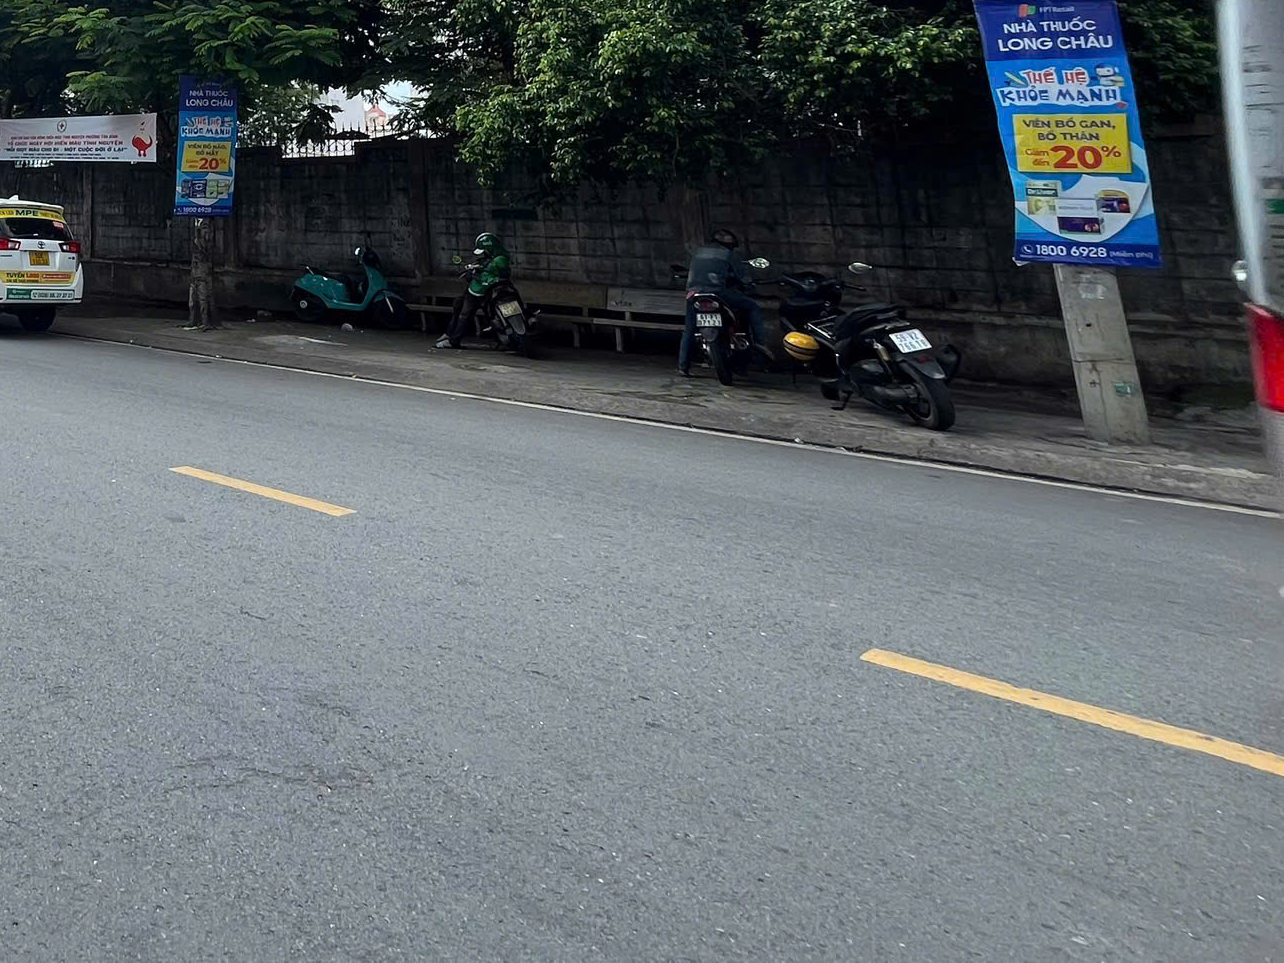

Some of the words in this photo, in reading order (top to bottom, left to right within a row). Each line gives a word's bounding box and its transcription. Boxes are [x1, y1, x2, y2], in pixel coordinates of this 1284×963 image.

[1003, 20, 1037, 34] NHÀ
[1040, 16, 1096, 32] THUỐC
[998, 37, 1052, 52] LONG
[1057, 33, 1114, 49] CHÂU
[1023, 67, 1055, 84] THẾ
[1064, 68, 1087, 85] HỆ
[206, 89, 229, 97] THUỐC
[999, 85, 1049, 103] KHỎE
[1056, 89, 1117, 104] MẠNH
[186, 99, 209, 107] LONG
[211, 98, 234, 107] CHÂU
[1022, 118, 1051, 128] VIÊN
[1055, 117, 1076, 128] BỔ
[1079, 120, 1116, 130] GAN,
[1037, 130, 1057, 141] BỔ
[1060, 131, 1100, 142] THẬN
[1051, 145, 1122, 169] 20%
[1036, 244, 1067, 256] 1800
[1070, 246, 1107, 257] 6928
